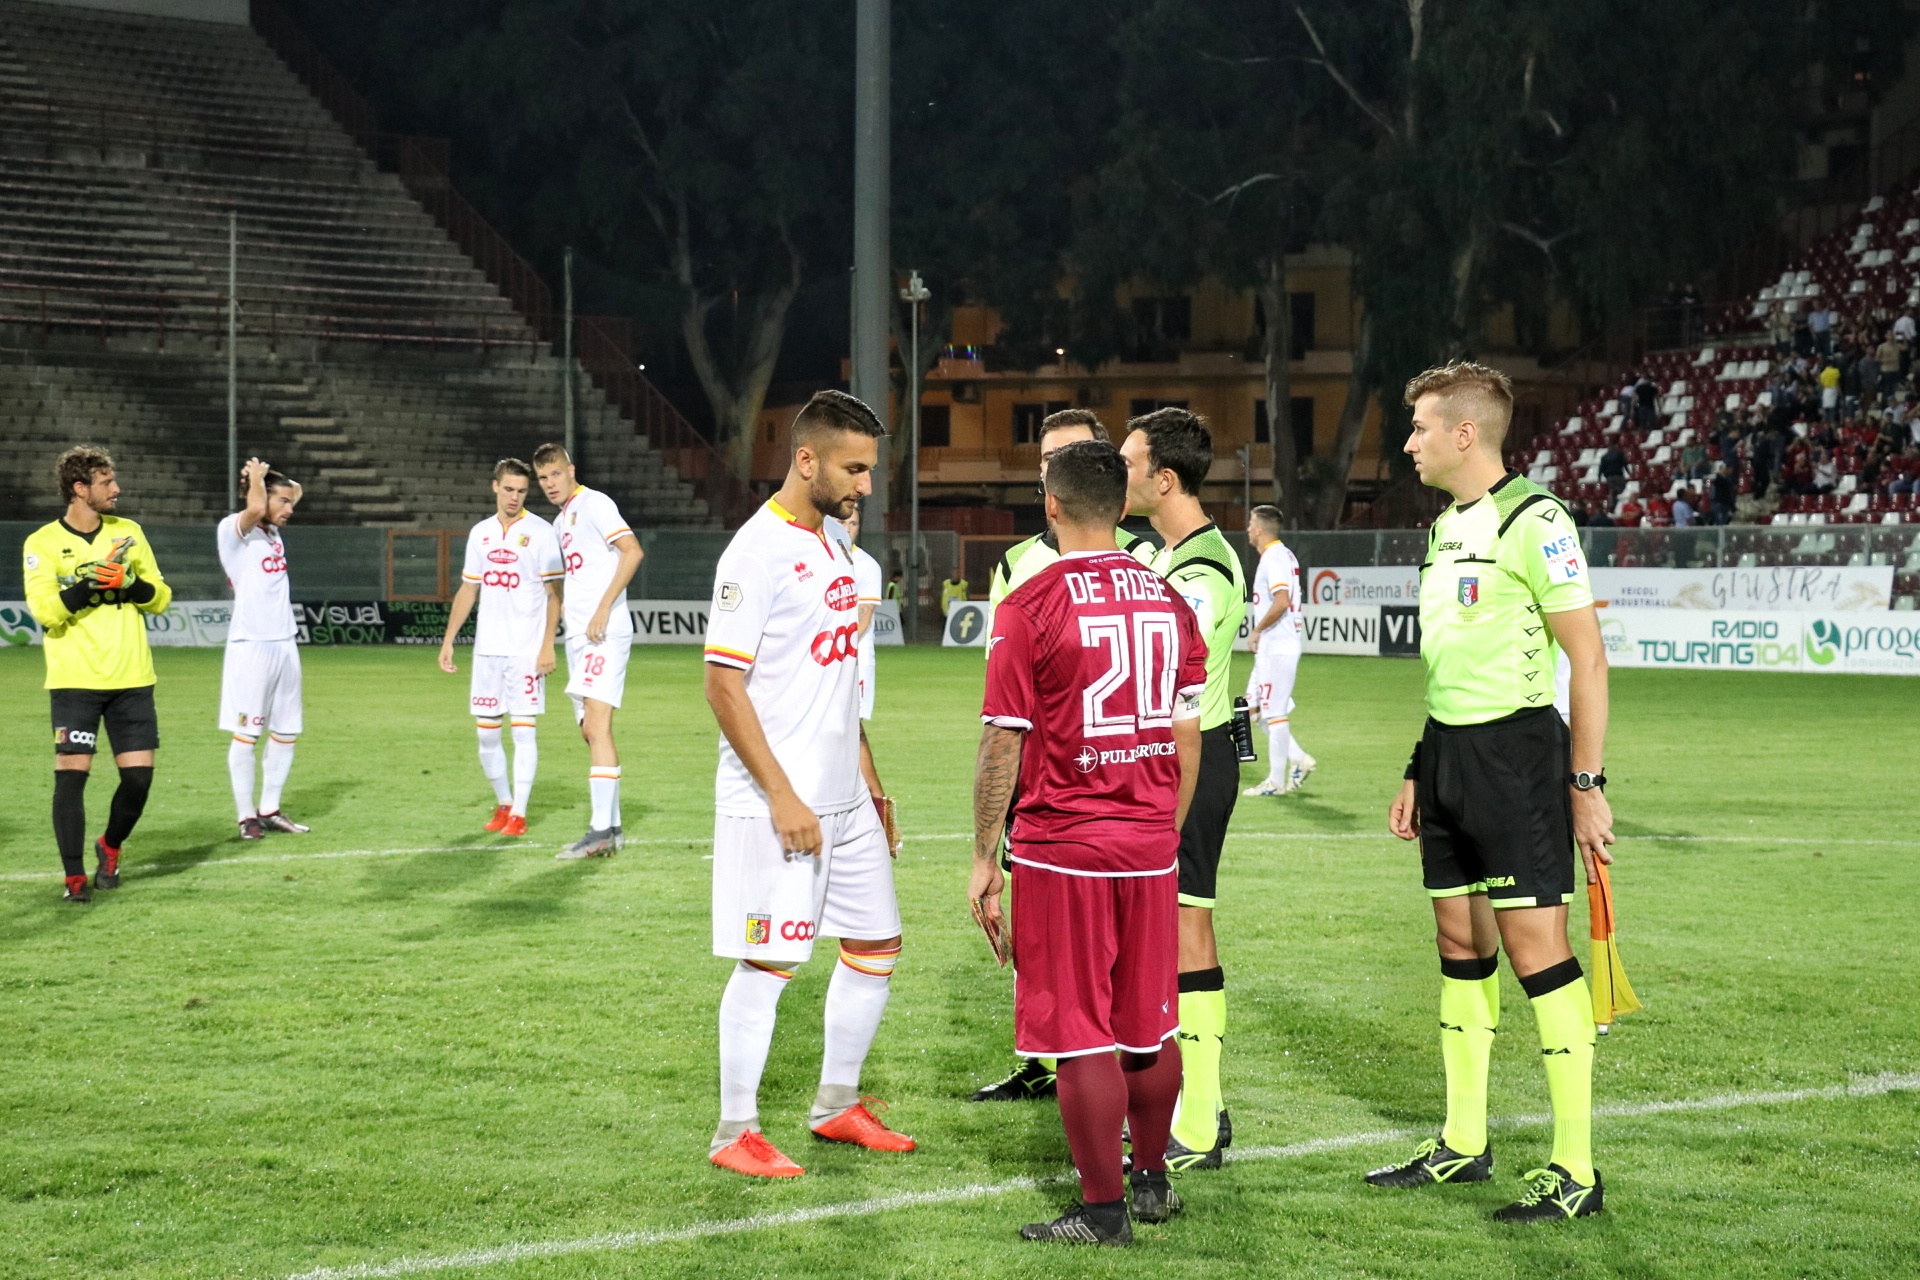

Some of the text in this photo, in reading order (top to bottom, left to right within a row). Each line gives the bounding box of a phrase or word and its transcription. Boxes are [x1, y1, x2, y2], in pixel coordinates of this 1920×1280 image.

[1438, 541, 1463, 552] LEGEA
[1064, 567, 1172, 605] DE ROSE
[1344, 583, 1402, 600] antenna
[387, 602, 440, 613] SPECIAL
[1712, 620, 1779, 640] RADIO
[584, 653, 606, 676] 18
[1078, 611, 1180, 738] 20
[1485, 875, 1516, 888] EGEA
